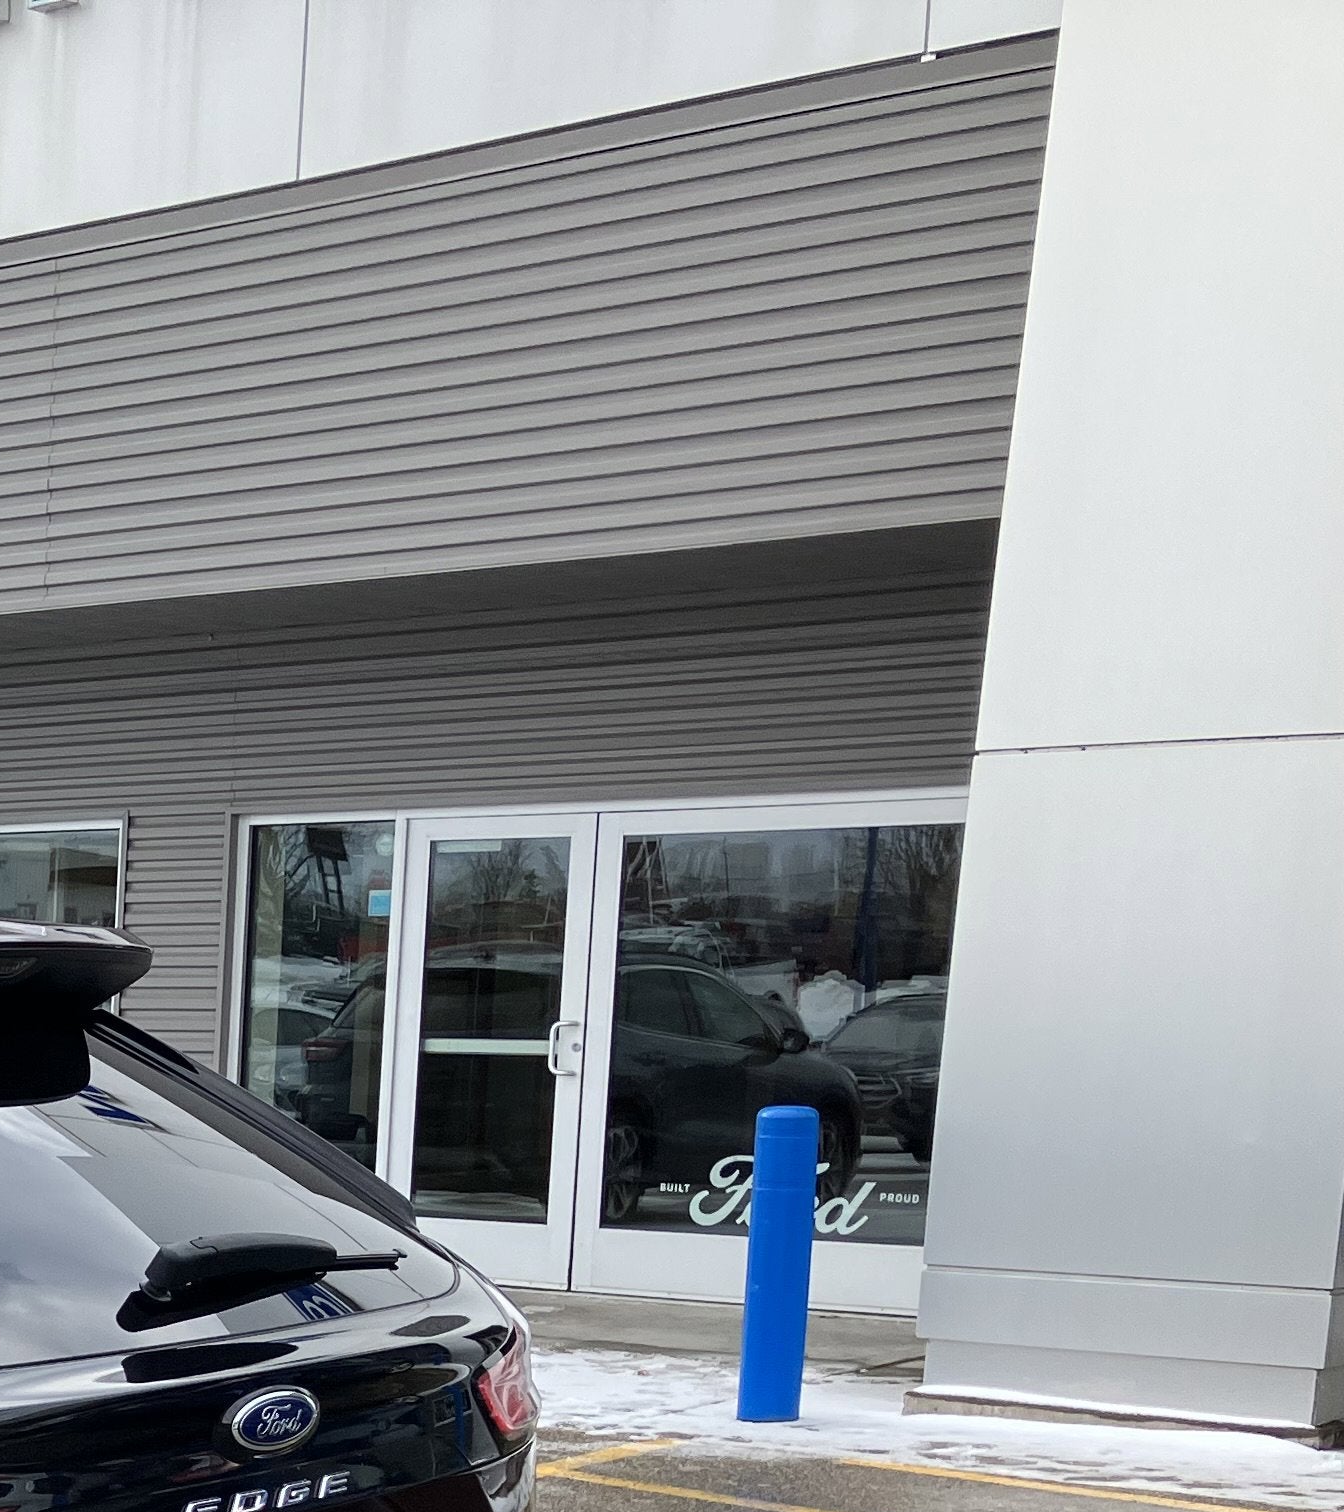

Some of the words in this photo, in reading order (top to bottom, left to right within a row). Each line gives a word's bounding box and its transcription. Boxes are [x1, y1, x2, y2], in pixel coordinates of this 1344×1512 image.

[659, 1182, 691, 1194] BUILT
[688, 1154, 878, 1236] Fd
[879, 1192, 920, 1205] PROUD
[256, 1403, 302, 1439] Ford
